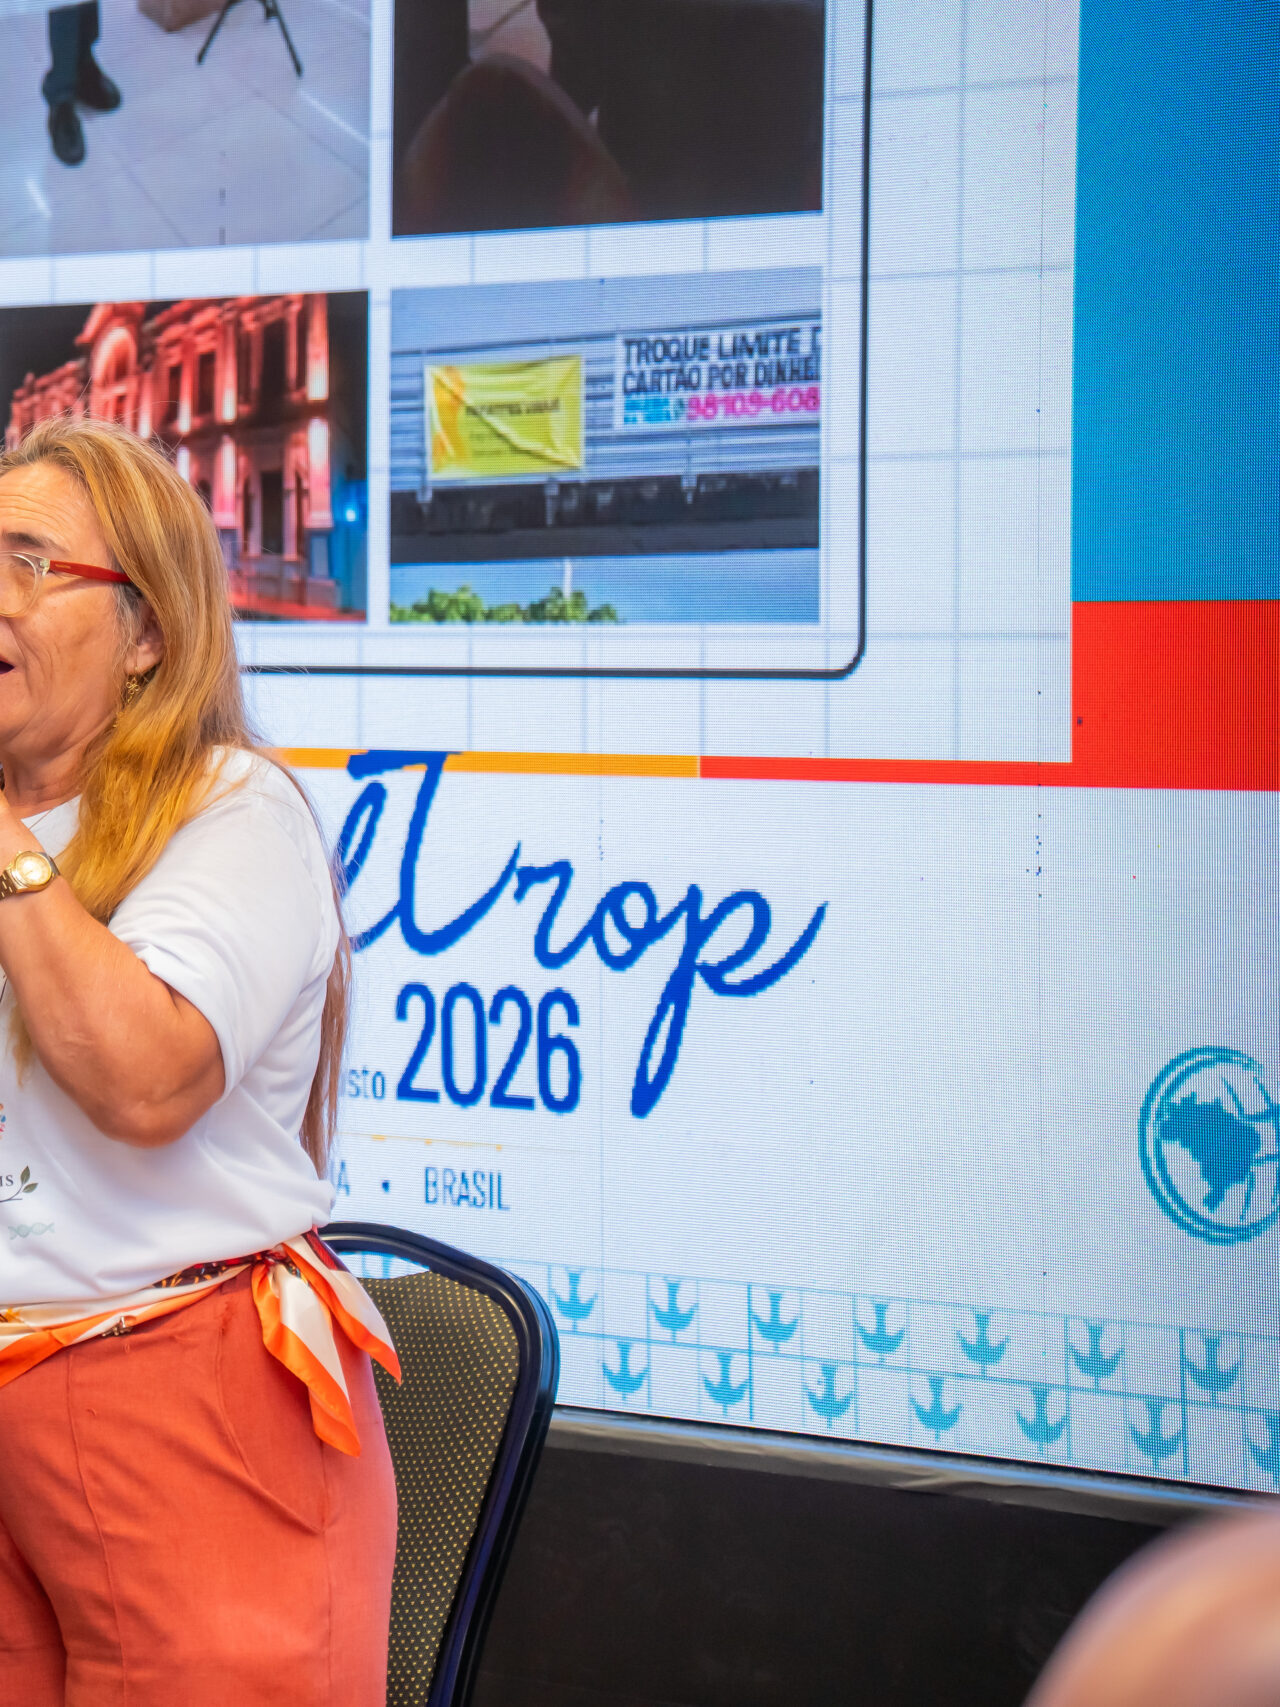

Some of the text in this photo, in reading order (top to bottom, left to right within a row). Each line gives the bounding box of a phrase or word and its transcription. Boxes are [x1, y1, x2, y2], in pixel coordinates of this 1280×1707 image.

[623, 337, 710, 368] TROQUE
[719, 326, 801, 358] LIMITE
[623, 365, 701, 394] CARTÃO
[707, 364, 748, 391] POR
[346, 982, 582, 1115] sto 2026
[424, 1166, 511, 1212] BRASIL
